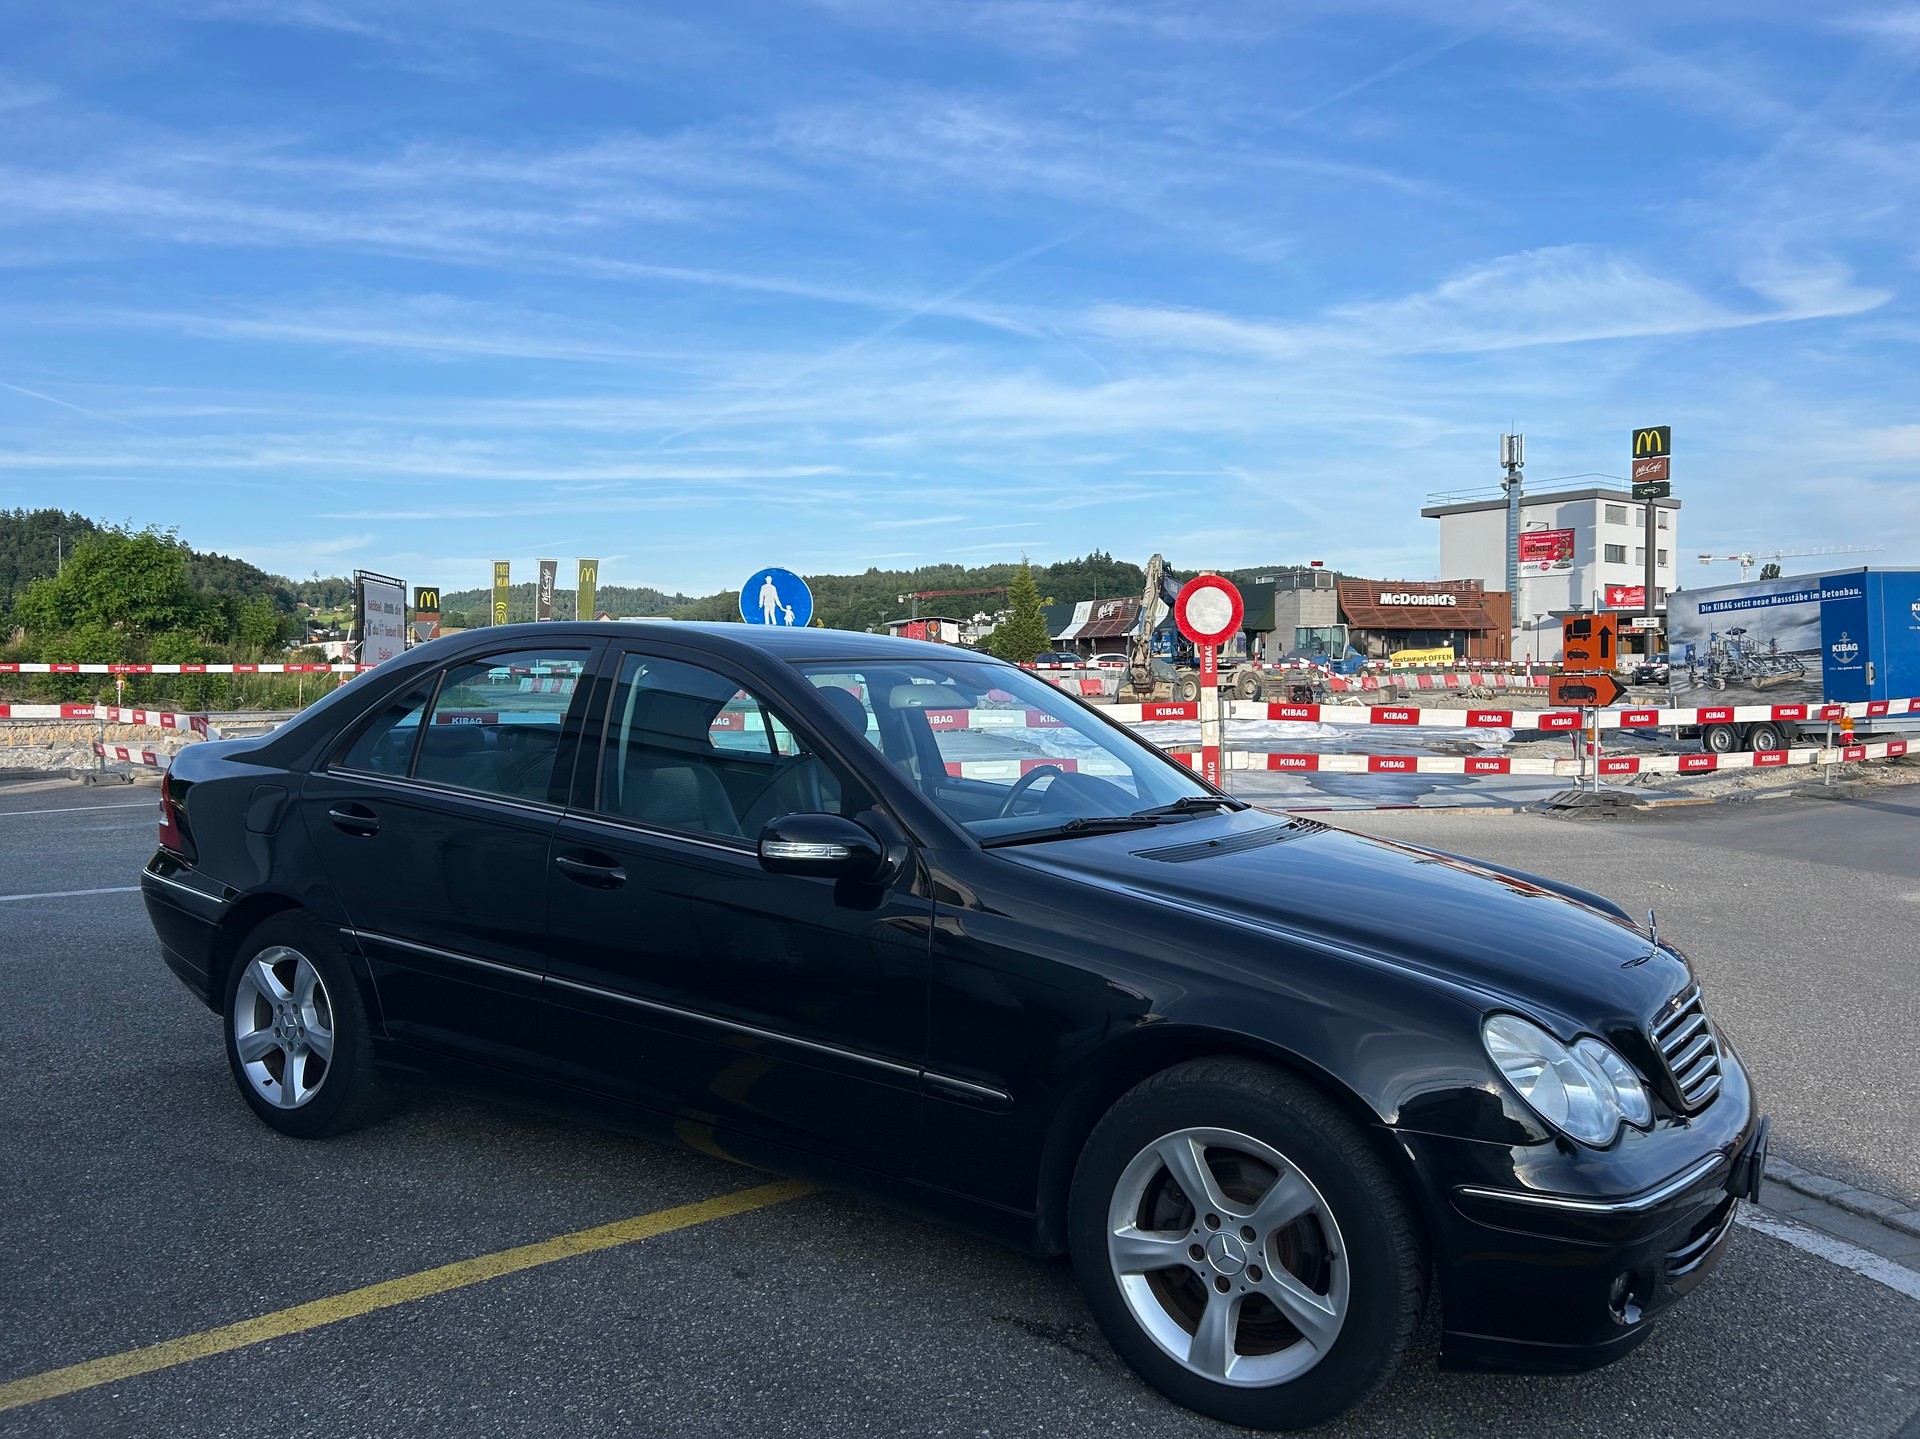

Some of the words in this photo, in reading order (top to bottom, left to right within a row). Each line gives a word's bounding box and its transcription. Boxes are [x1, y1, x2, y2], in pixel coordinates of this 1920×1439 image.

[1524, 545, 1553, 553] DÖNER
[496, 564, 509, 575] FREE
[1379, 593, 1456, 606] McDonald's
[1701, 604, 1712, 612] Die
[1713, 601, 1732, 611] KIBAG
[1753, 598, 1769, 606] neue
[1771, 594, 1808, 604] Massstäbe
[1810, 591, 1820, 599] im
[1821, 588, 1862, 599] Betonbau.
[1832, 643, 1858, 652] KIBAG
[1205, 645, 1213, 674] KIBAG
[1156, 707, 1185, 715] KIBAG
[1281, 708, 1308, 717] KIBAG
[1705, 711, 1726, 719] KIBAG
[927, 715, 953, 724] IBAG
[1040, 715, 1060, 723] KIB
[1383, 712, 1408, 720] KIBAG
[1478, 715, 1502, 723] KIBAG
[1629, 714, 1649, 722] KIBAG
[452, 717, 483, 725] KIBAG
[1551, 718, 1572, 726] KIBAG
[1280, 758, 1306, 766] KIBAG
[1380, 760, 1405, 768] KIBAG
[1475, 762, 1500, 770] KIBAG
[1608, 762, 1629, 770] KIBAG
[1207, 761, 1216, 785] IBAG
